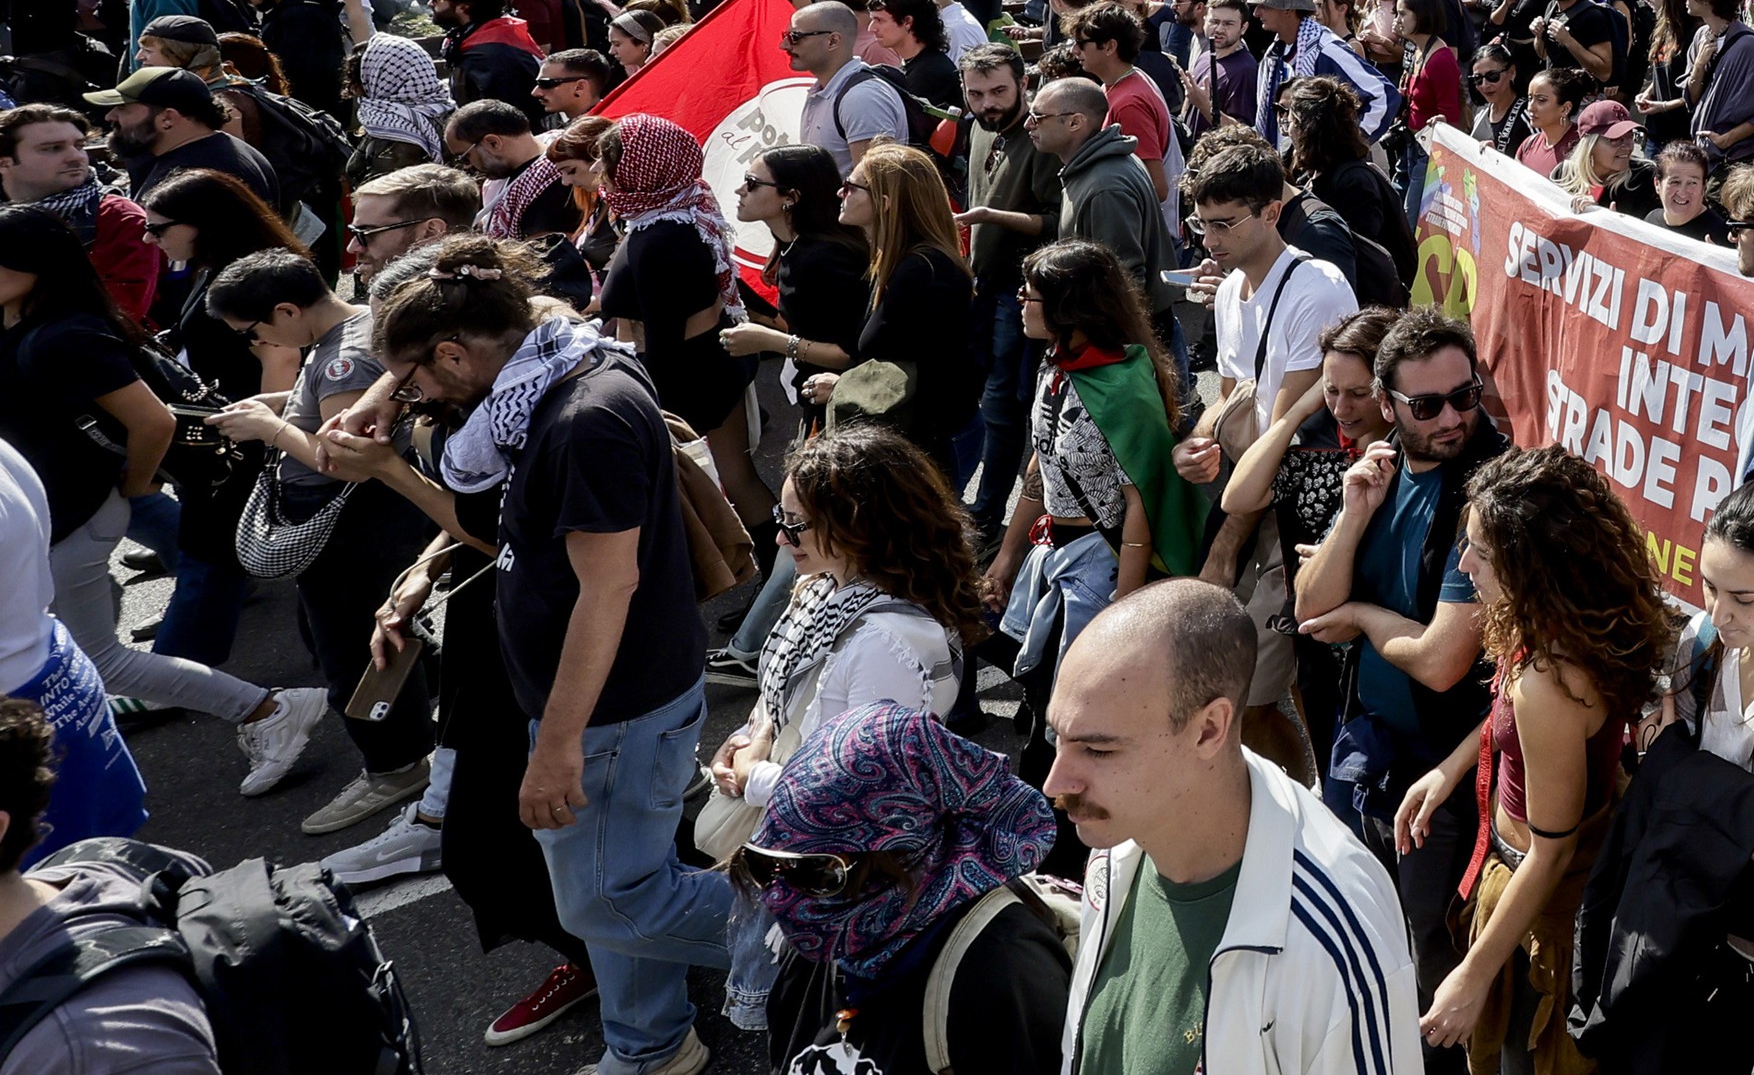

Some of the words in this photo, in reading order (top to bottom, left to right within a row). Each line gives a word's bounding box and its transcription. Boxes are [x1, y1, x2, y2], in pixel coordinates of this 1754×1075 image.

[1504, 221, 1626, 331] SERVIZI
[1630, 276, 1687, 356] DI
[1547, 368, 1682, 510] STRADE
